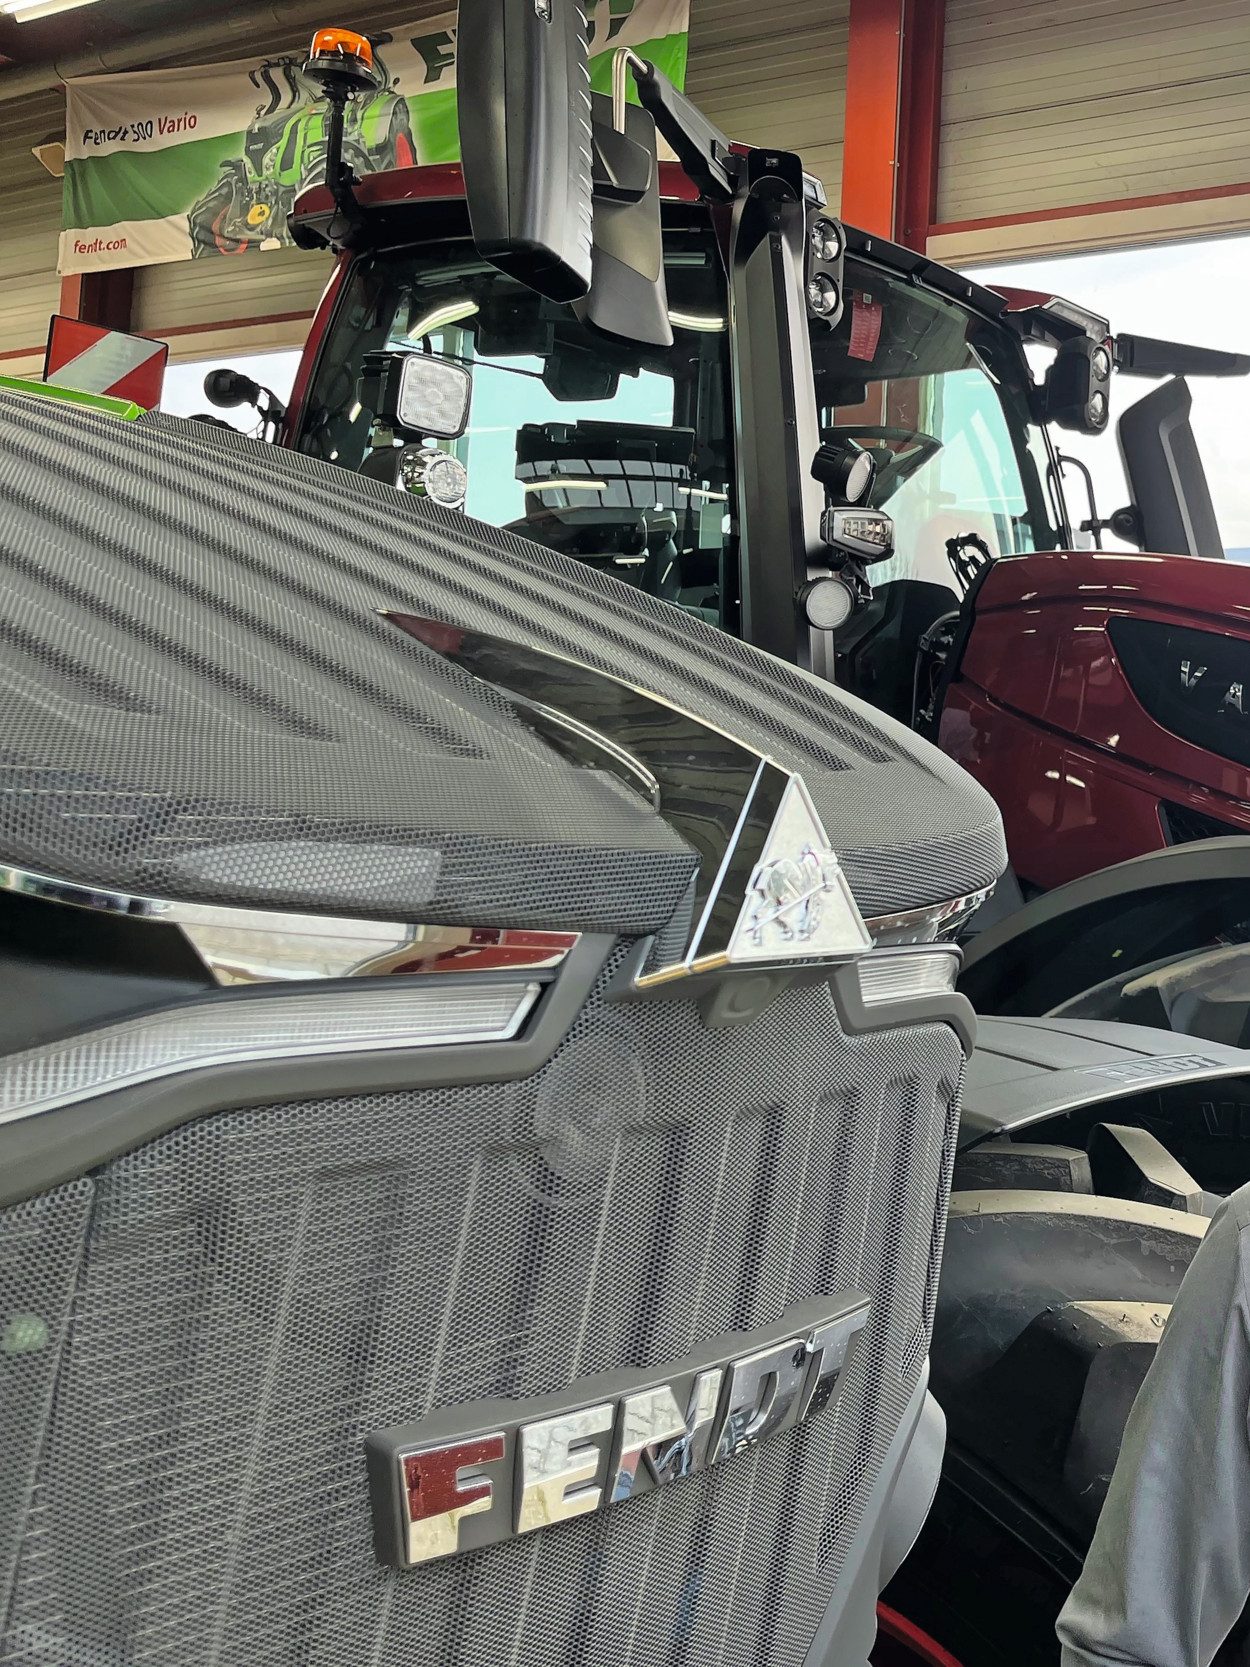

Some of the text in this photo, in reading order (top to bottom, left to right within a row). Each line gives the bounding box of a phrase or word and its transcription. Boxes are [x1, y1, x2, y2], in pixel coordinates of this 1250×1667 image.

[83, 112, 197, 145] Fendt 500 Vario
[398, 1300, 870, 1565] FENDT
